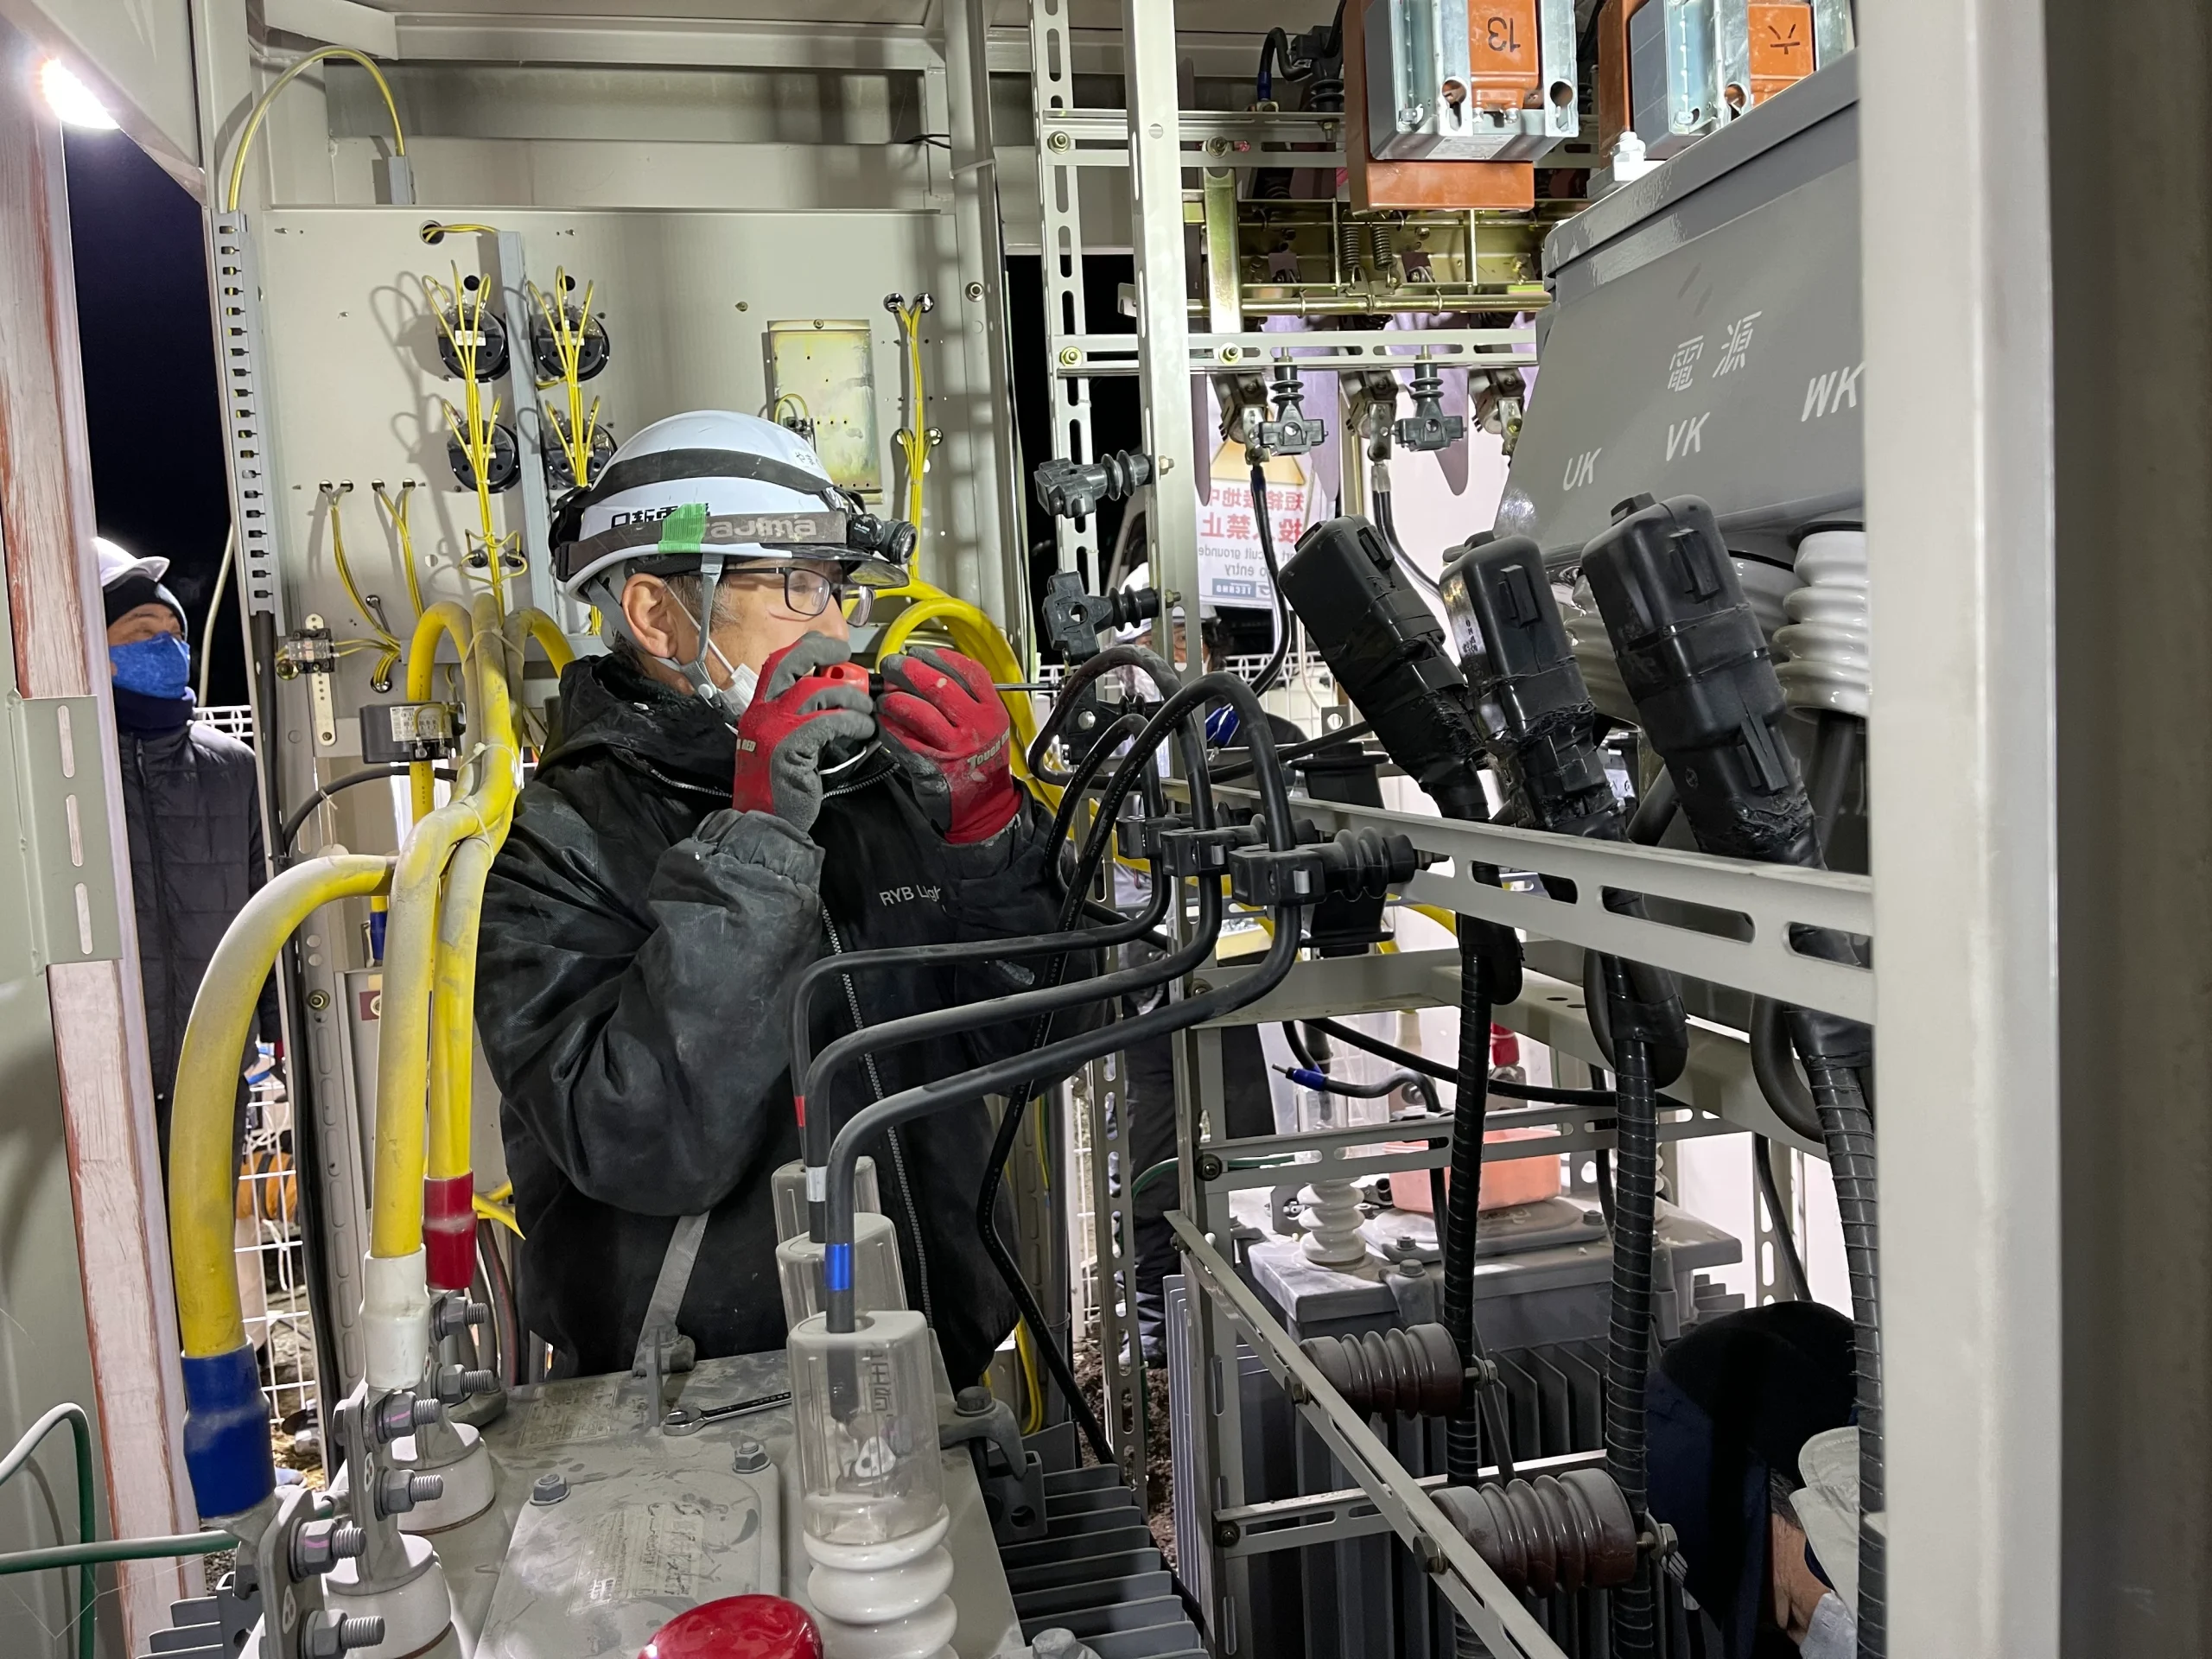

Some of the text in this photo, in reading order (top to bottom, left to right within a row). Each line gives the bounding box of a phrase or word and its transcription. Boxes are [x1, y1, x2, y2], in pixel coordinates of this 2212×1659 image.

[1668, 310, 1763, 392] 電源
[1801, 361, 1866, 422] WK
[1666, 411, 1710, 461] VK
[1562, 447, 1602, 491] UK
[879, 886, 915, 906] RYB
